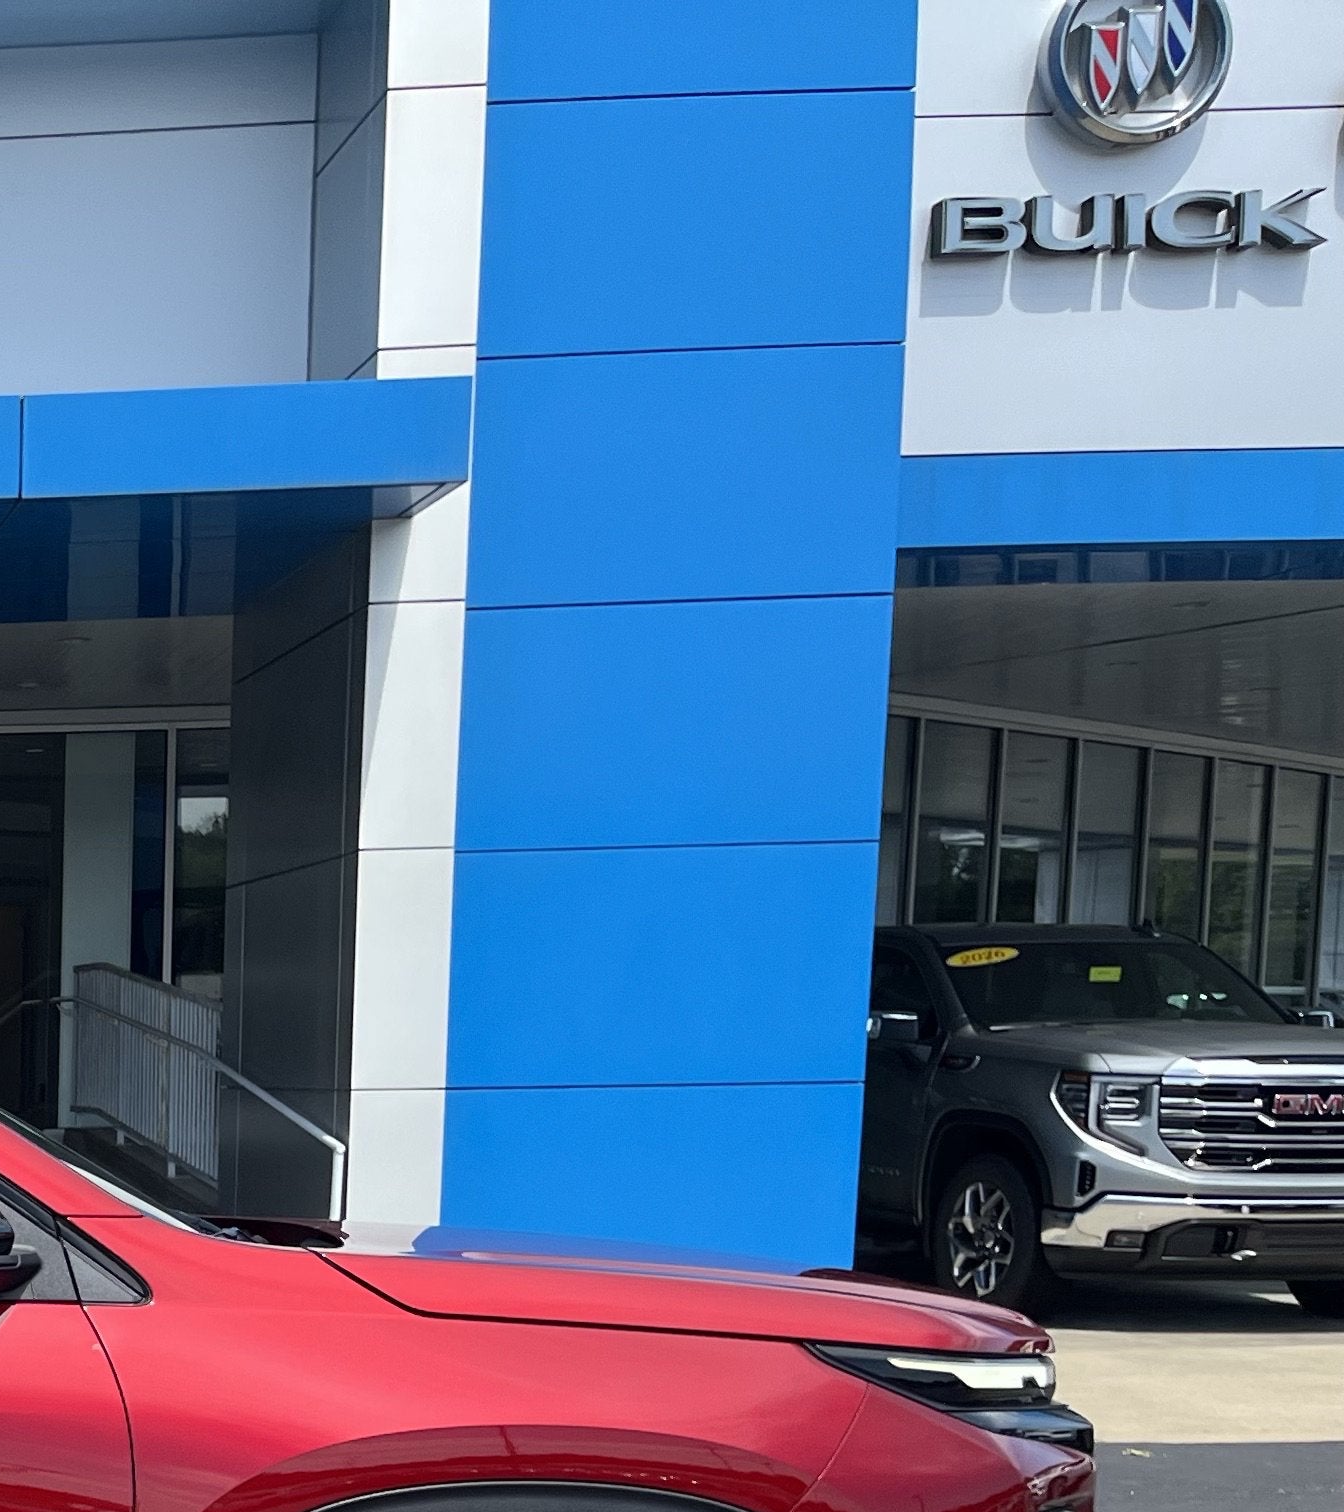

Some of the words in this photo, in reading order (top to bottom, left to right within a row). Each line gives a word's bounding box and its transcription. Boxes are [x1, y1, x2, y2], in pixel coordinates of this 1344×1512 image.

[928, 187, 1328, 259] BUICK
[958, 950, 1007, 965] 2026
[1272, 1093, 1344, 1116] GM
